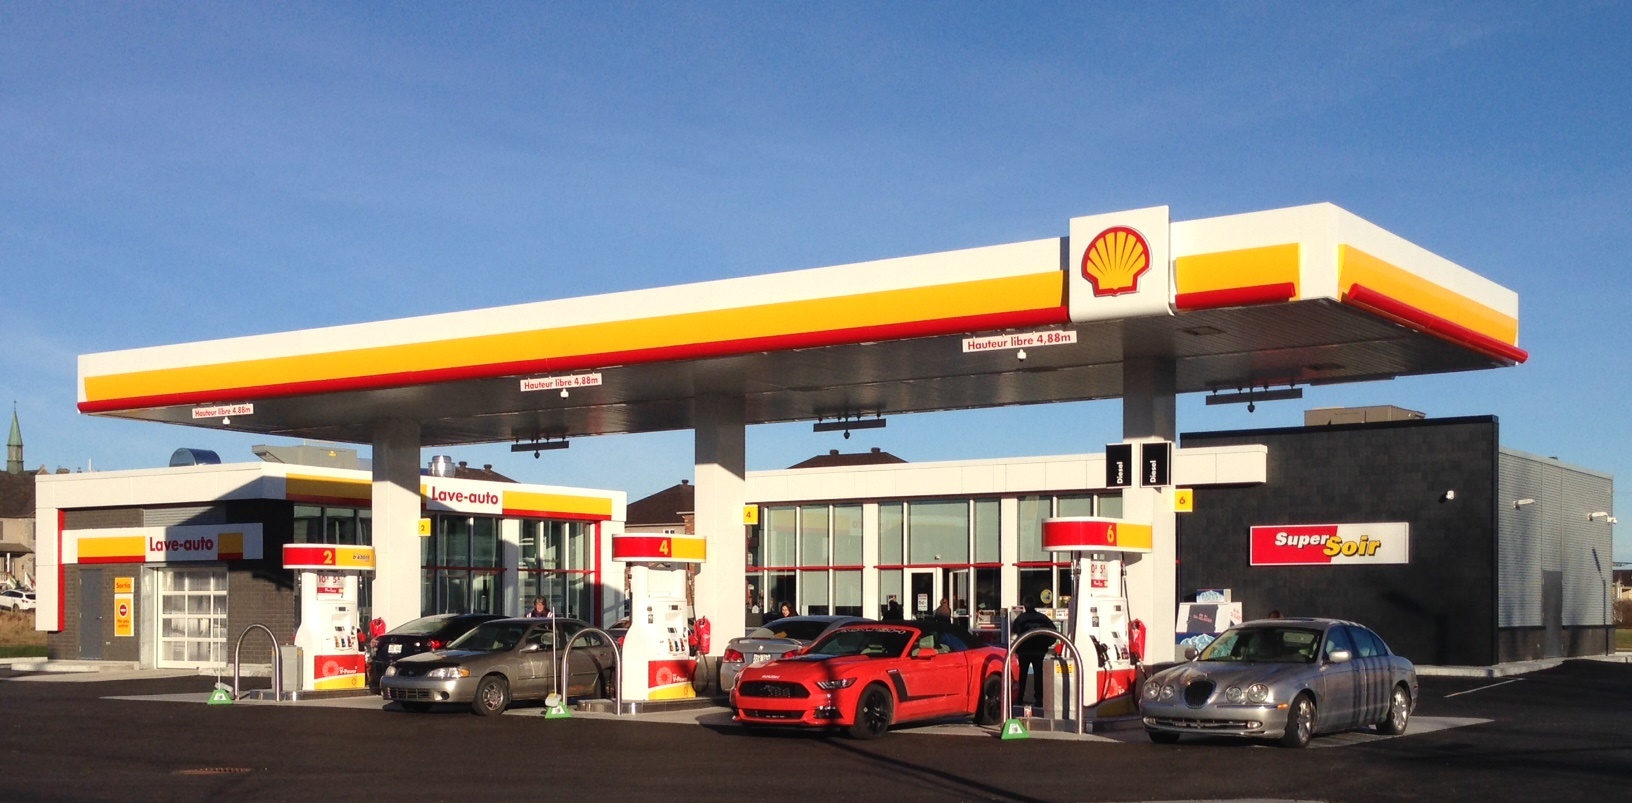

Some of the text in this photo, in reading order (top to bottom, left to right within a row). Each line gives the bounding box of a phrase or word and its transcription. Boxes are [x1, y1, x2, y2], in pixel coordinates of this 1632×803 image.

[967, 333, 1071, 350] Hauteur libre 4,88m
[524, 376, 598, 389] Hauteur libre 4,88m
[218, 407, 231, 415] libre
[1149, 460, 1157, 483] Diesel
[431, 486, 499, 505] Lave-auto
[1179, 496, 1186, 505] 6
[746, 511, 752, 519] 4
[1106, 524, 1115, 543] 6
[149, 536, 214, 552] Lave-auto
[659, 540, 669, 555] 4
[1274, 532, 1382, 557] Super Soir
[323, 550, 333, 564] 2
